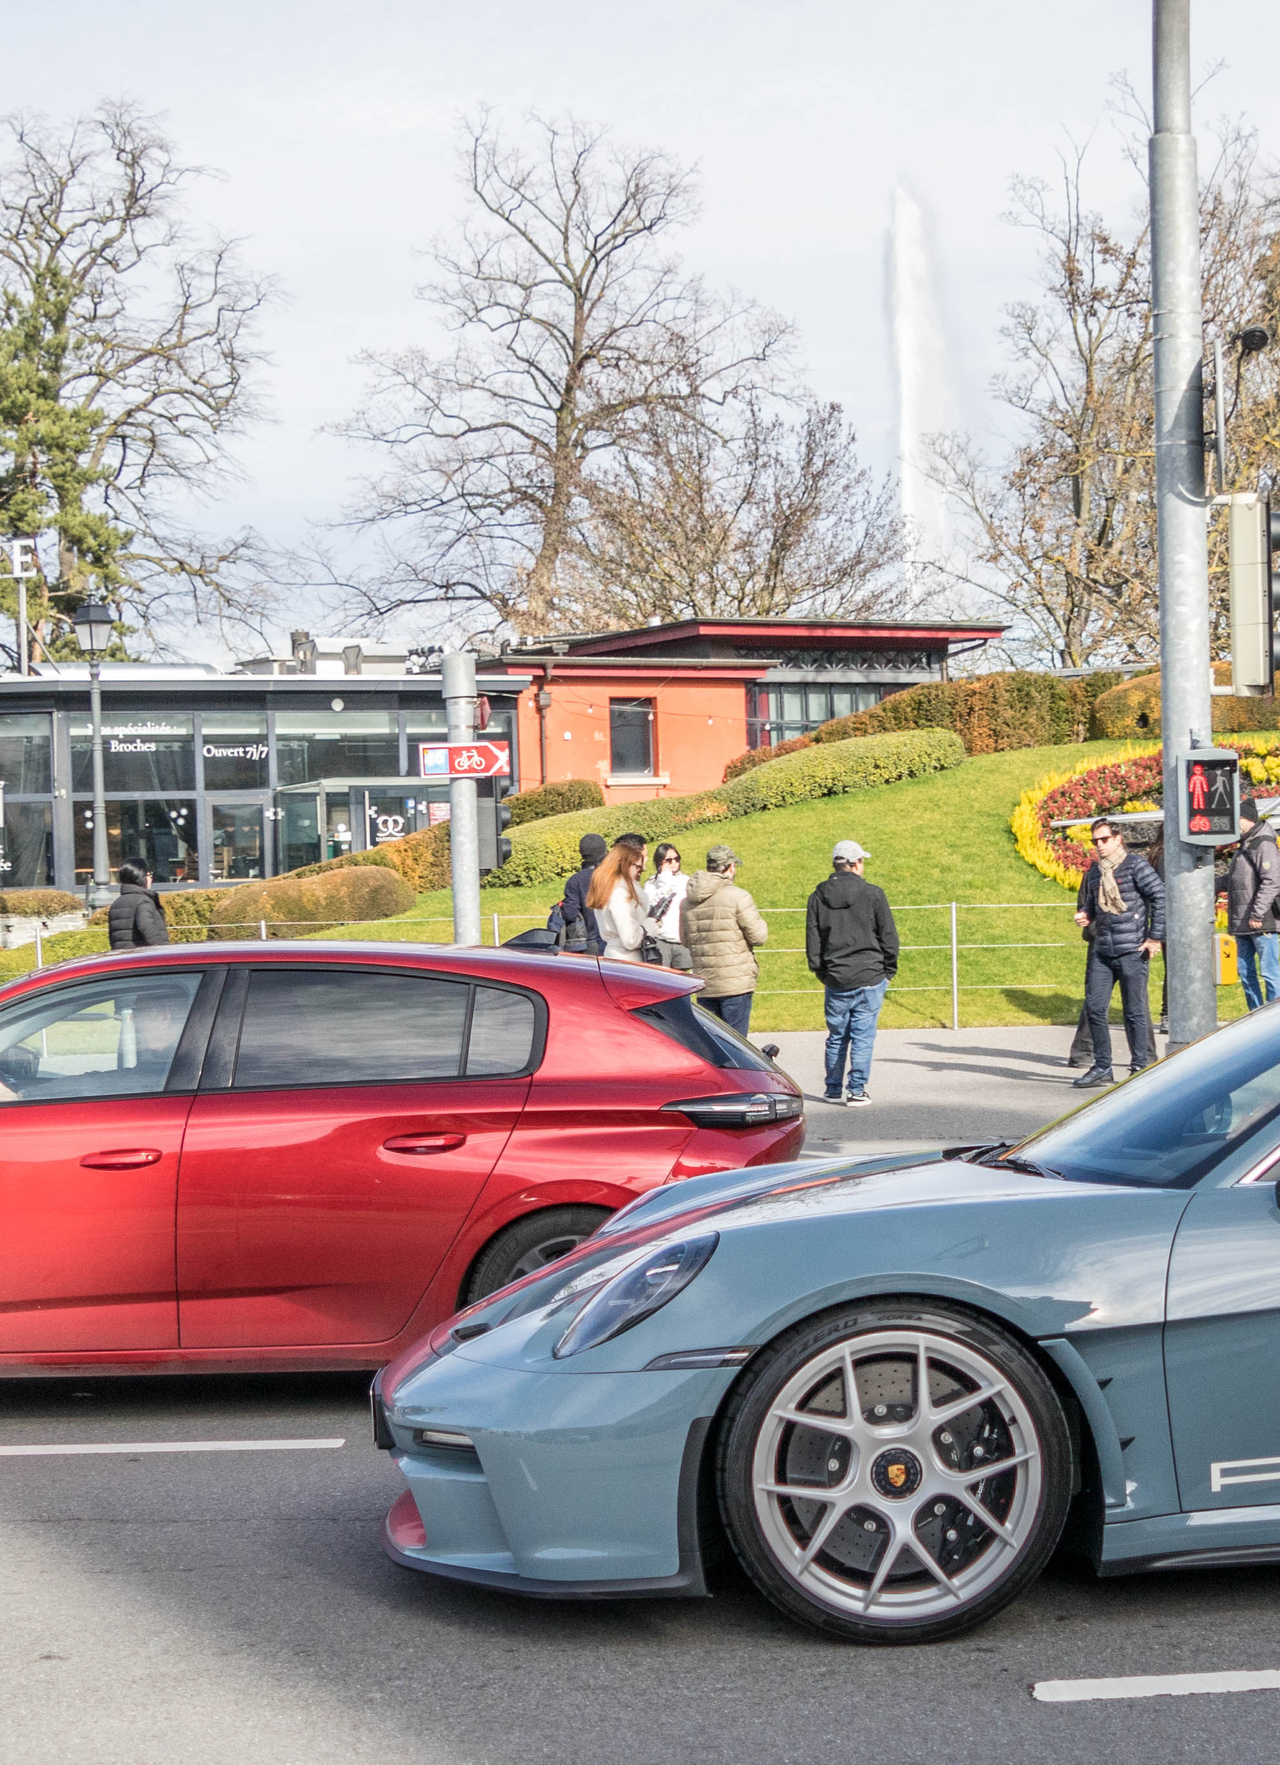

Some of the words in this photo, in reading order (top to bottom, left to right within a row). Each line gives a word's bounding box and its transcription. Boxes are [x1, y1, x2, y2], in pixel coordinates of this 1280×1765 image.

[109, 739, 157, 752] Broches
[202, 745, 245, 757] Ouvert
[245, 744, 269, 760] 7j/7
